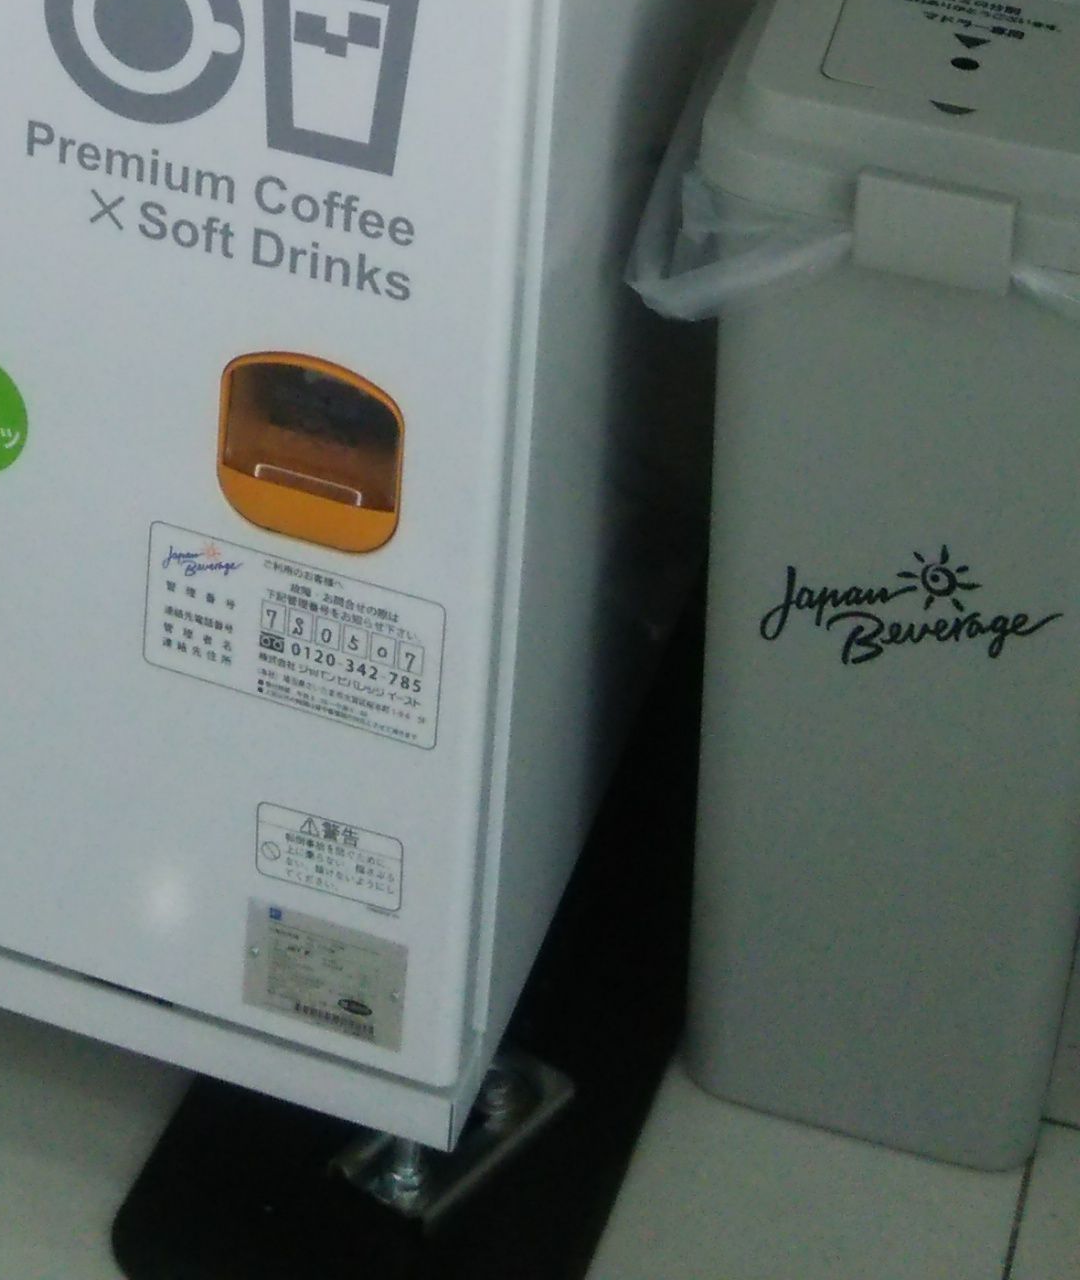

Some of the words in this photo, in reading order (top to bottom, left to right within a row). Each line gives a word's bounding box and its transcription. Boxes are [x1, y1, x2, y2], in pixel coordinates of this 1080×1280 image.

[26, 118, 236, 204] Premium
[254, 174, 416, 247] Coffee
[138, 200, 235, 259] Soft
[251, 226, 411, 302] Drinks
[760, 565, 917, 641] Japan
[827, 611, 1064, 665] Beverage
[322, 821, 359, 848] 警告
